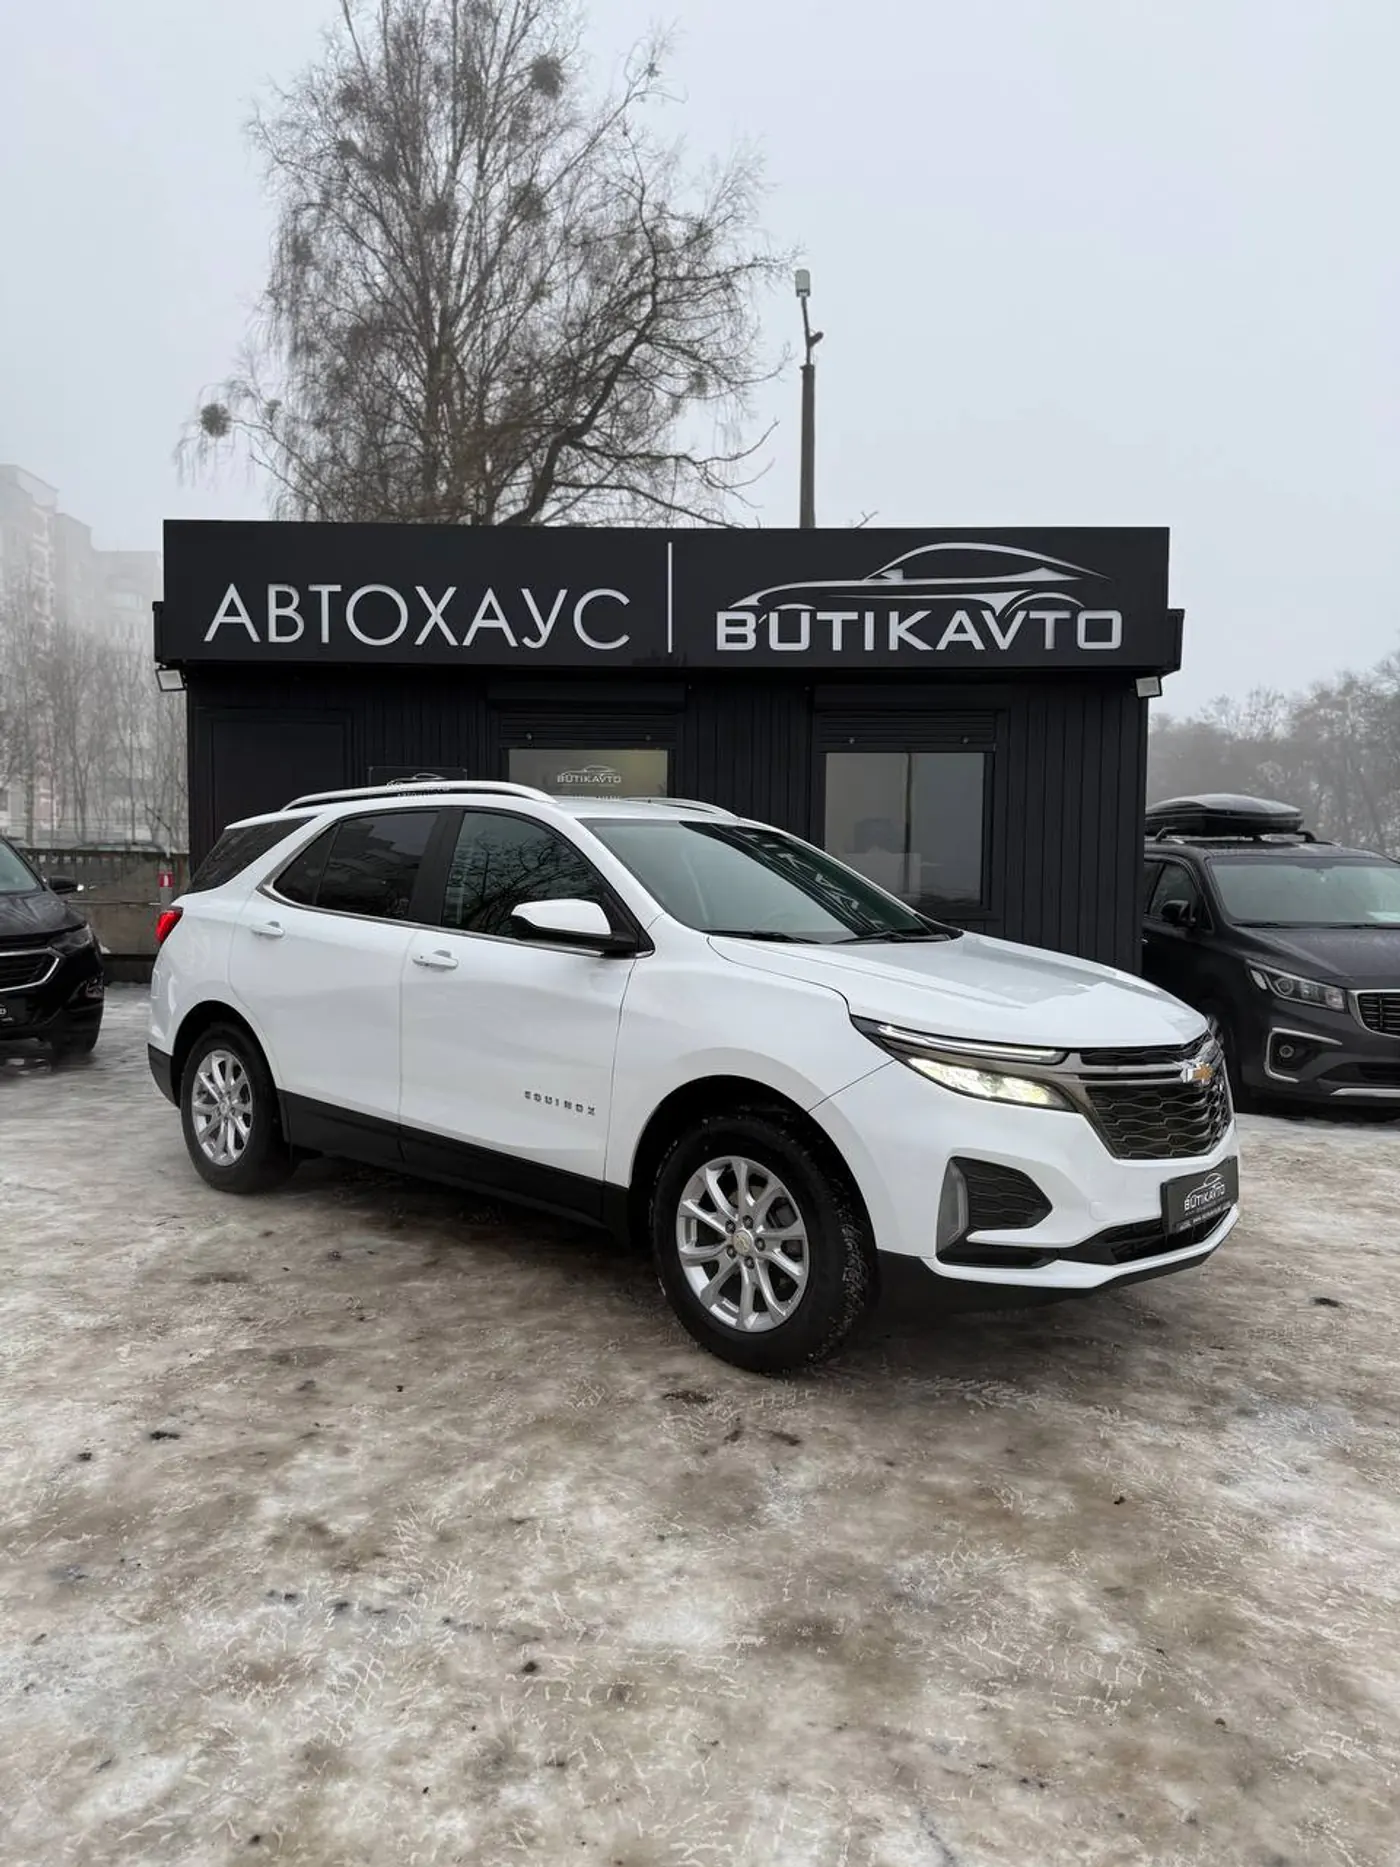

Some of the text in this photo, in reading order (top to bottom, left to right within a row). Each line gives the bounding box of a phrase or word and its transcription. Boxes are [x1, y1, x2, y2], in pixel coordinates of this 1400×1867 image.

[203, 583, 631, 651] АВТОХАУС
[716, 609, 1123, 652] BUTIKAVTO
[557, 774, 622, 784] BUTIKAVTO
[524, 1090, 596, 1116] EQUINOX
